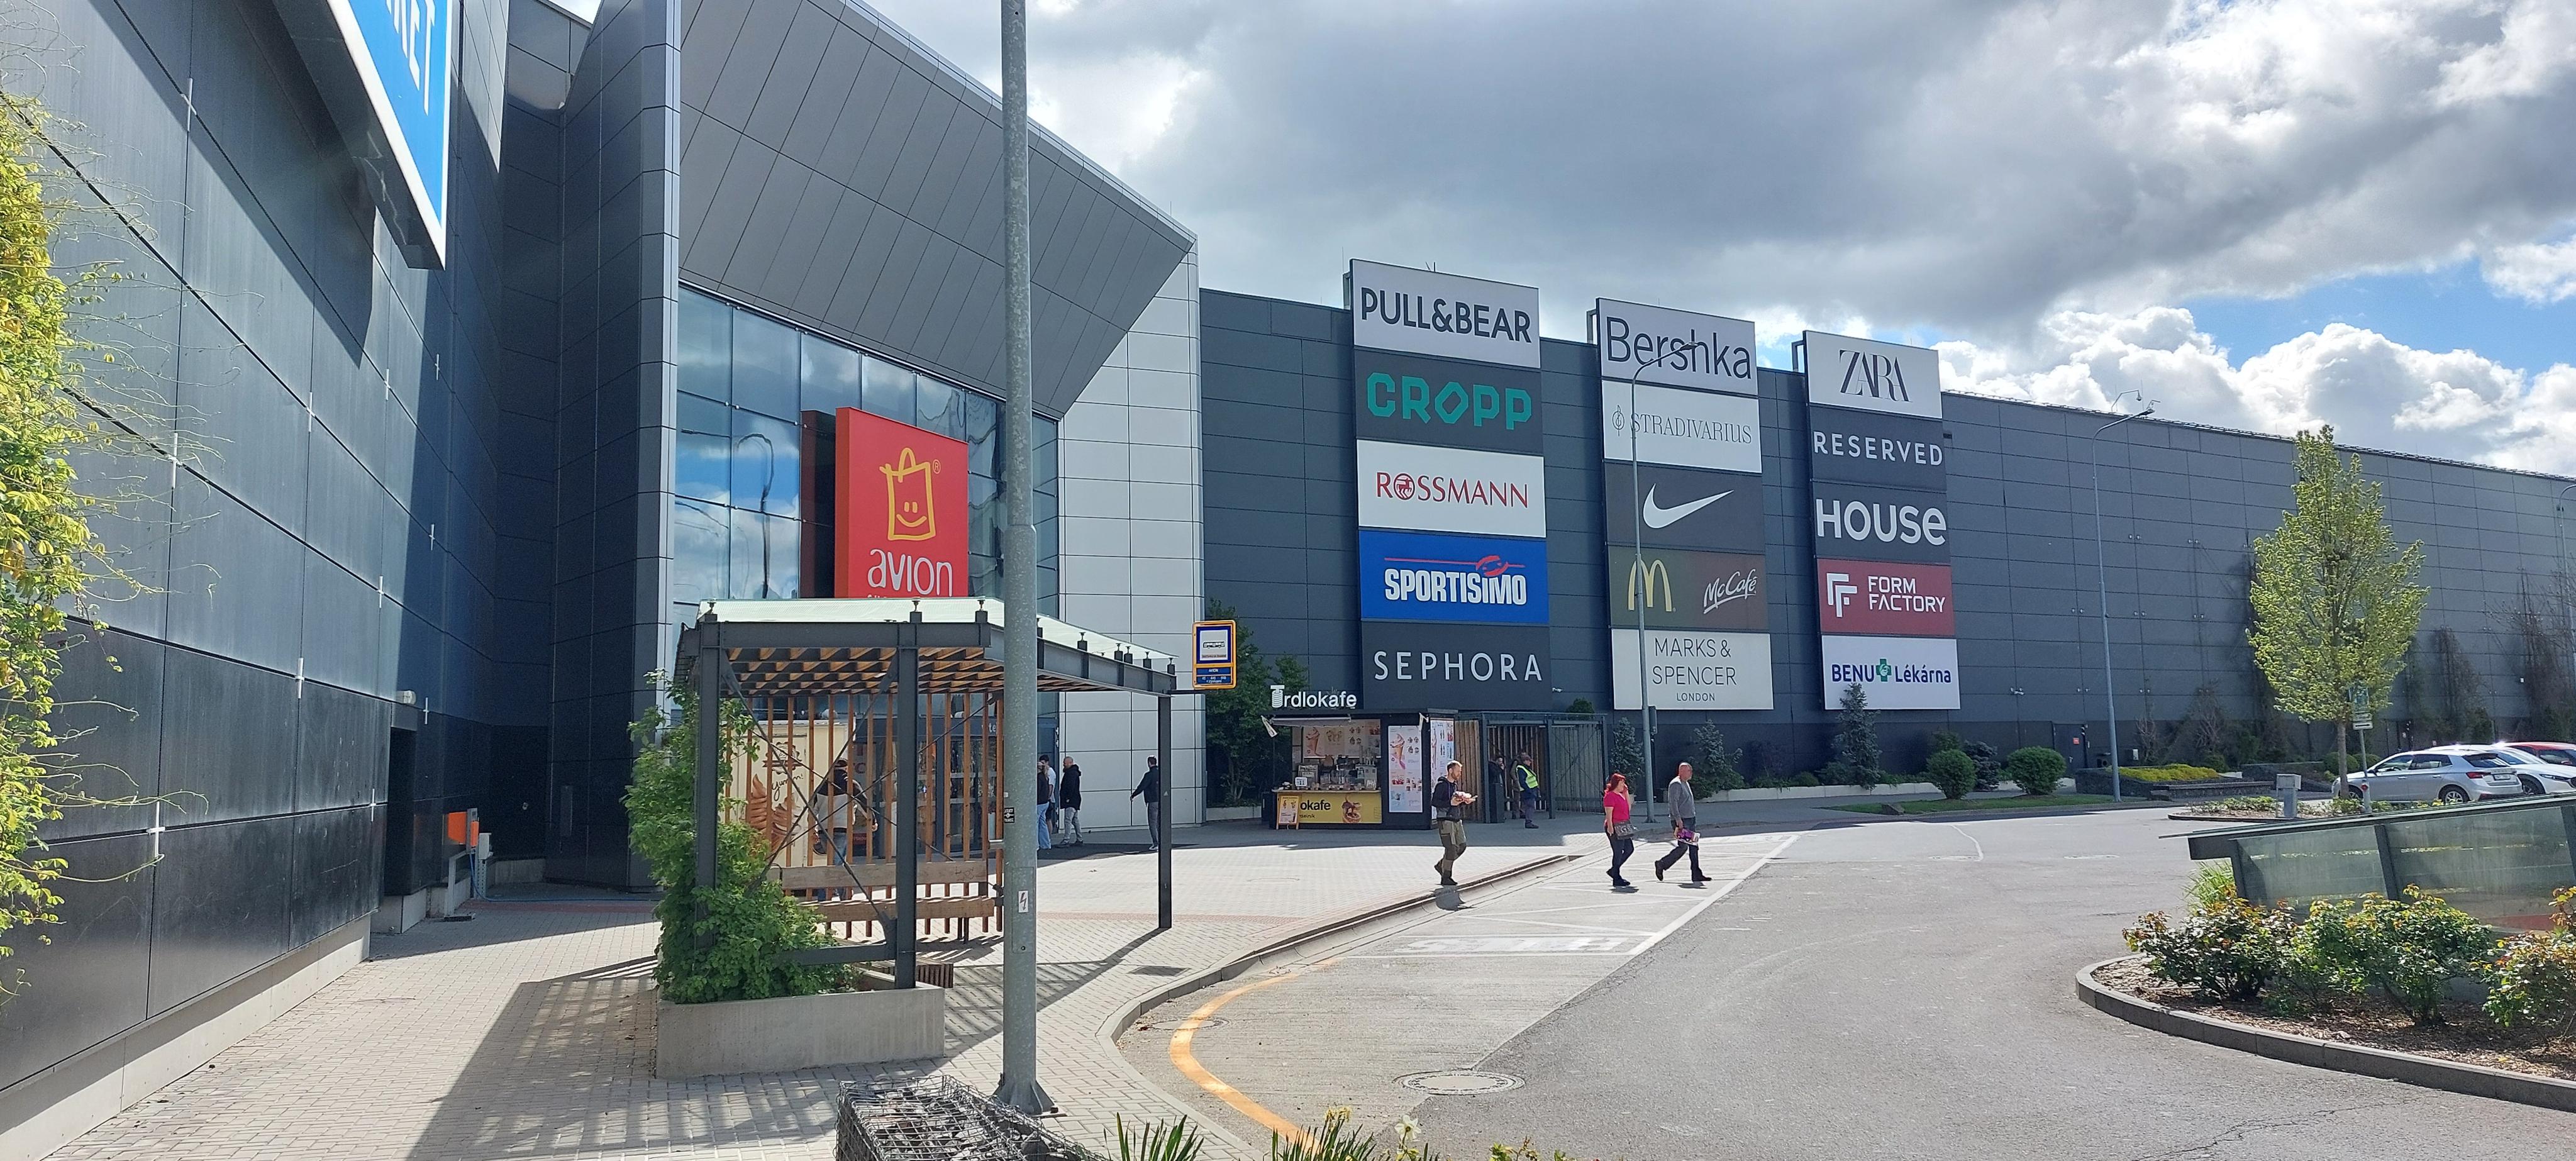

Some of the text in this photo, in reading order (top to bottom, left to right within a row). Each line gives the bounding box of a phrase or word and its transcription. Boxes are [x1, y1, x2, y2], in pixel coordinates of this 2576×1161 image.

[1361, 287, 1531, 343] PULL&BEAR
[1606, 316, 1752, 379] Bershka
[1839, 349, 1913, 403] ZARA
[1367, 372, 1532, 430] CROPP
[1629, 412, 1752, 444] STRADIVARIUS
[1813, 431, 1943, 466] RESERVED
[1376, 472, 1528, 508] ROSSMANN
[868, 548, 953, 597] avion
[1384, 568, 1527, 605] SPORTISIMO
[1703, 569, 1758, 609] McCafé
[1868, 575, 1916, 594] FORM
[1869, 594, 1946, 613] FACTORY
[1654, 638, 1731, 658] MARKS &
[1374, 650, 1542, 681] SEPHORA
[1652, 665, 1737, 685] SPENCER
[1831, 664, 1951, 683] BENU Lékárna
[1676, 692, 1716, 702] LONDON
[1300, 799, 1331, 811] okafe
